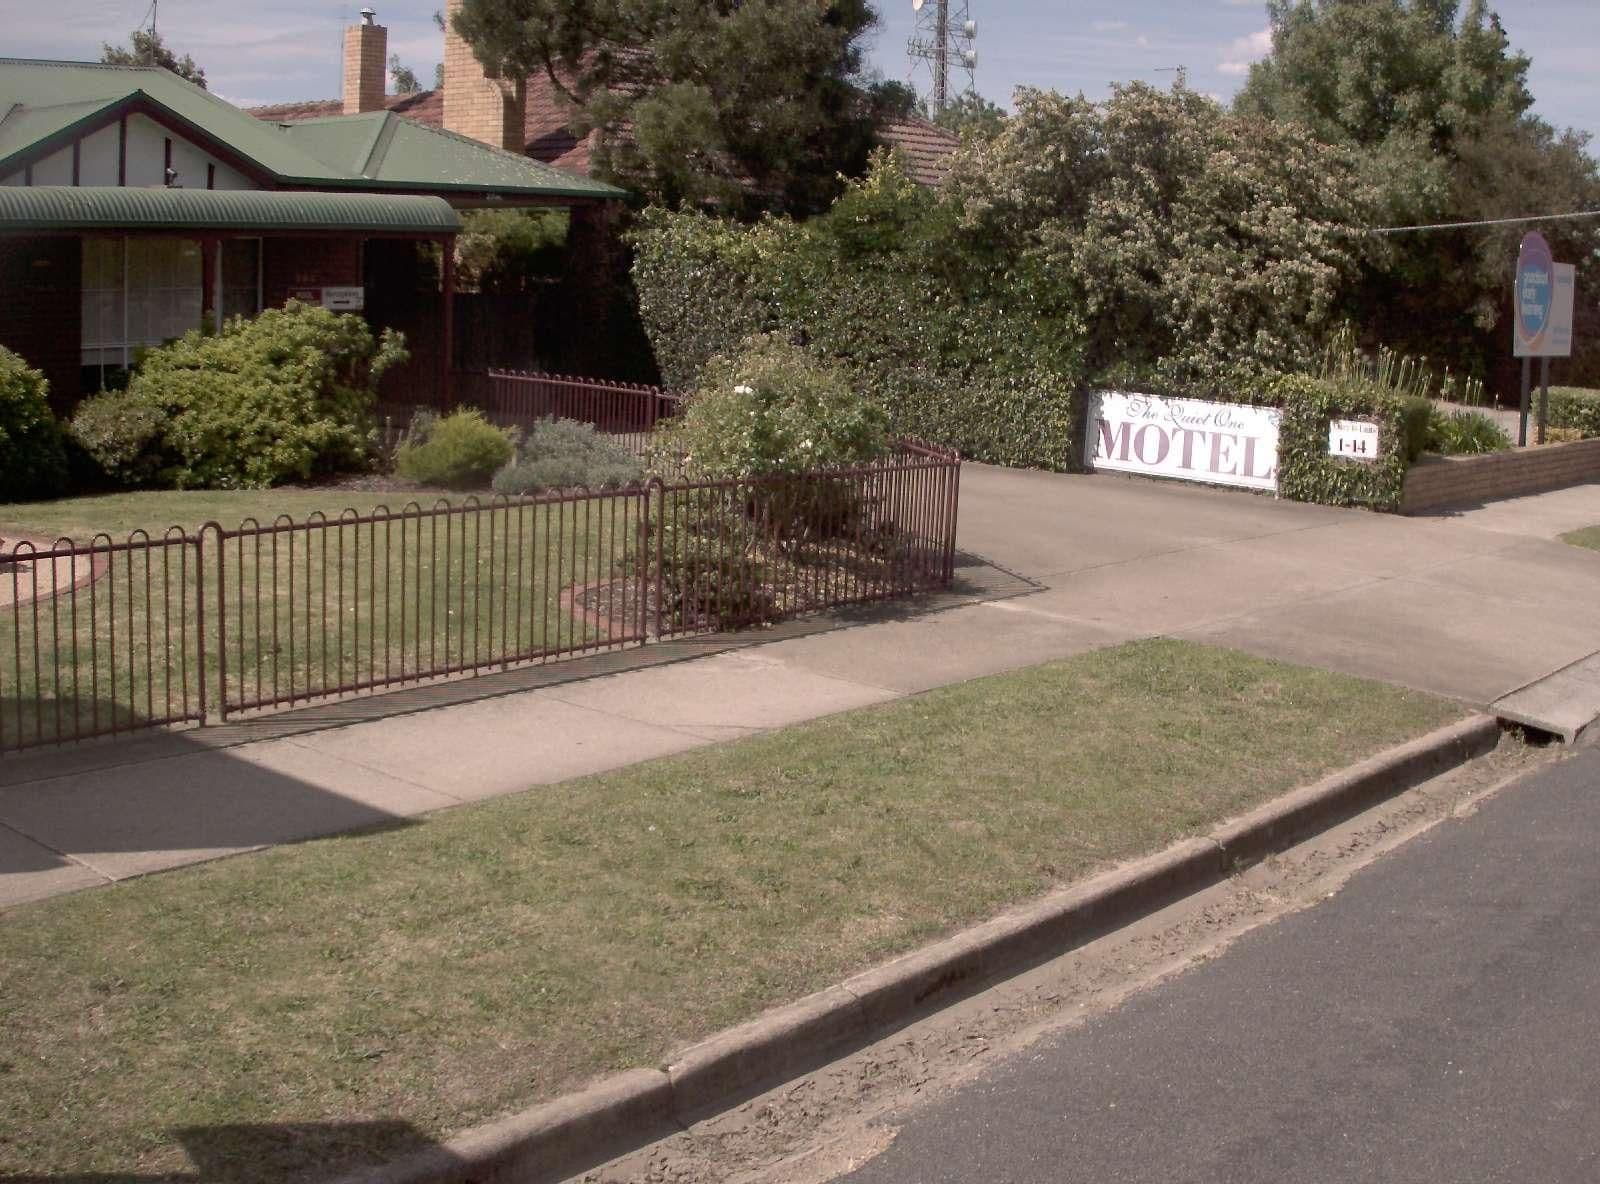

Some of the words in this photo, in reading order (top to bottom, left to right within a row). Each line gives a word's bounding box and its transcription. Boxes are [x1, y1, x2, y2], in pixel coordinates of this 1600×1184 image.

[1126, 398, 1158, 420] The
[1164, 403, 1211, 430] Quiet
[1214, 408, 1245, 429] One
[1095, 418, 1273, 480] MOTEL
[1339, 438, 1367, 454] 1-14
